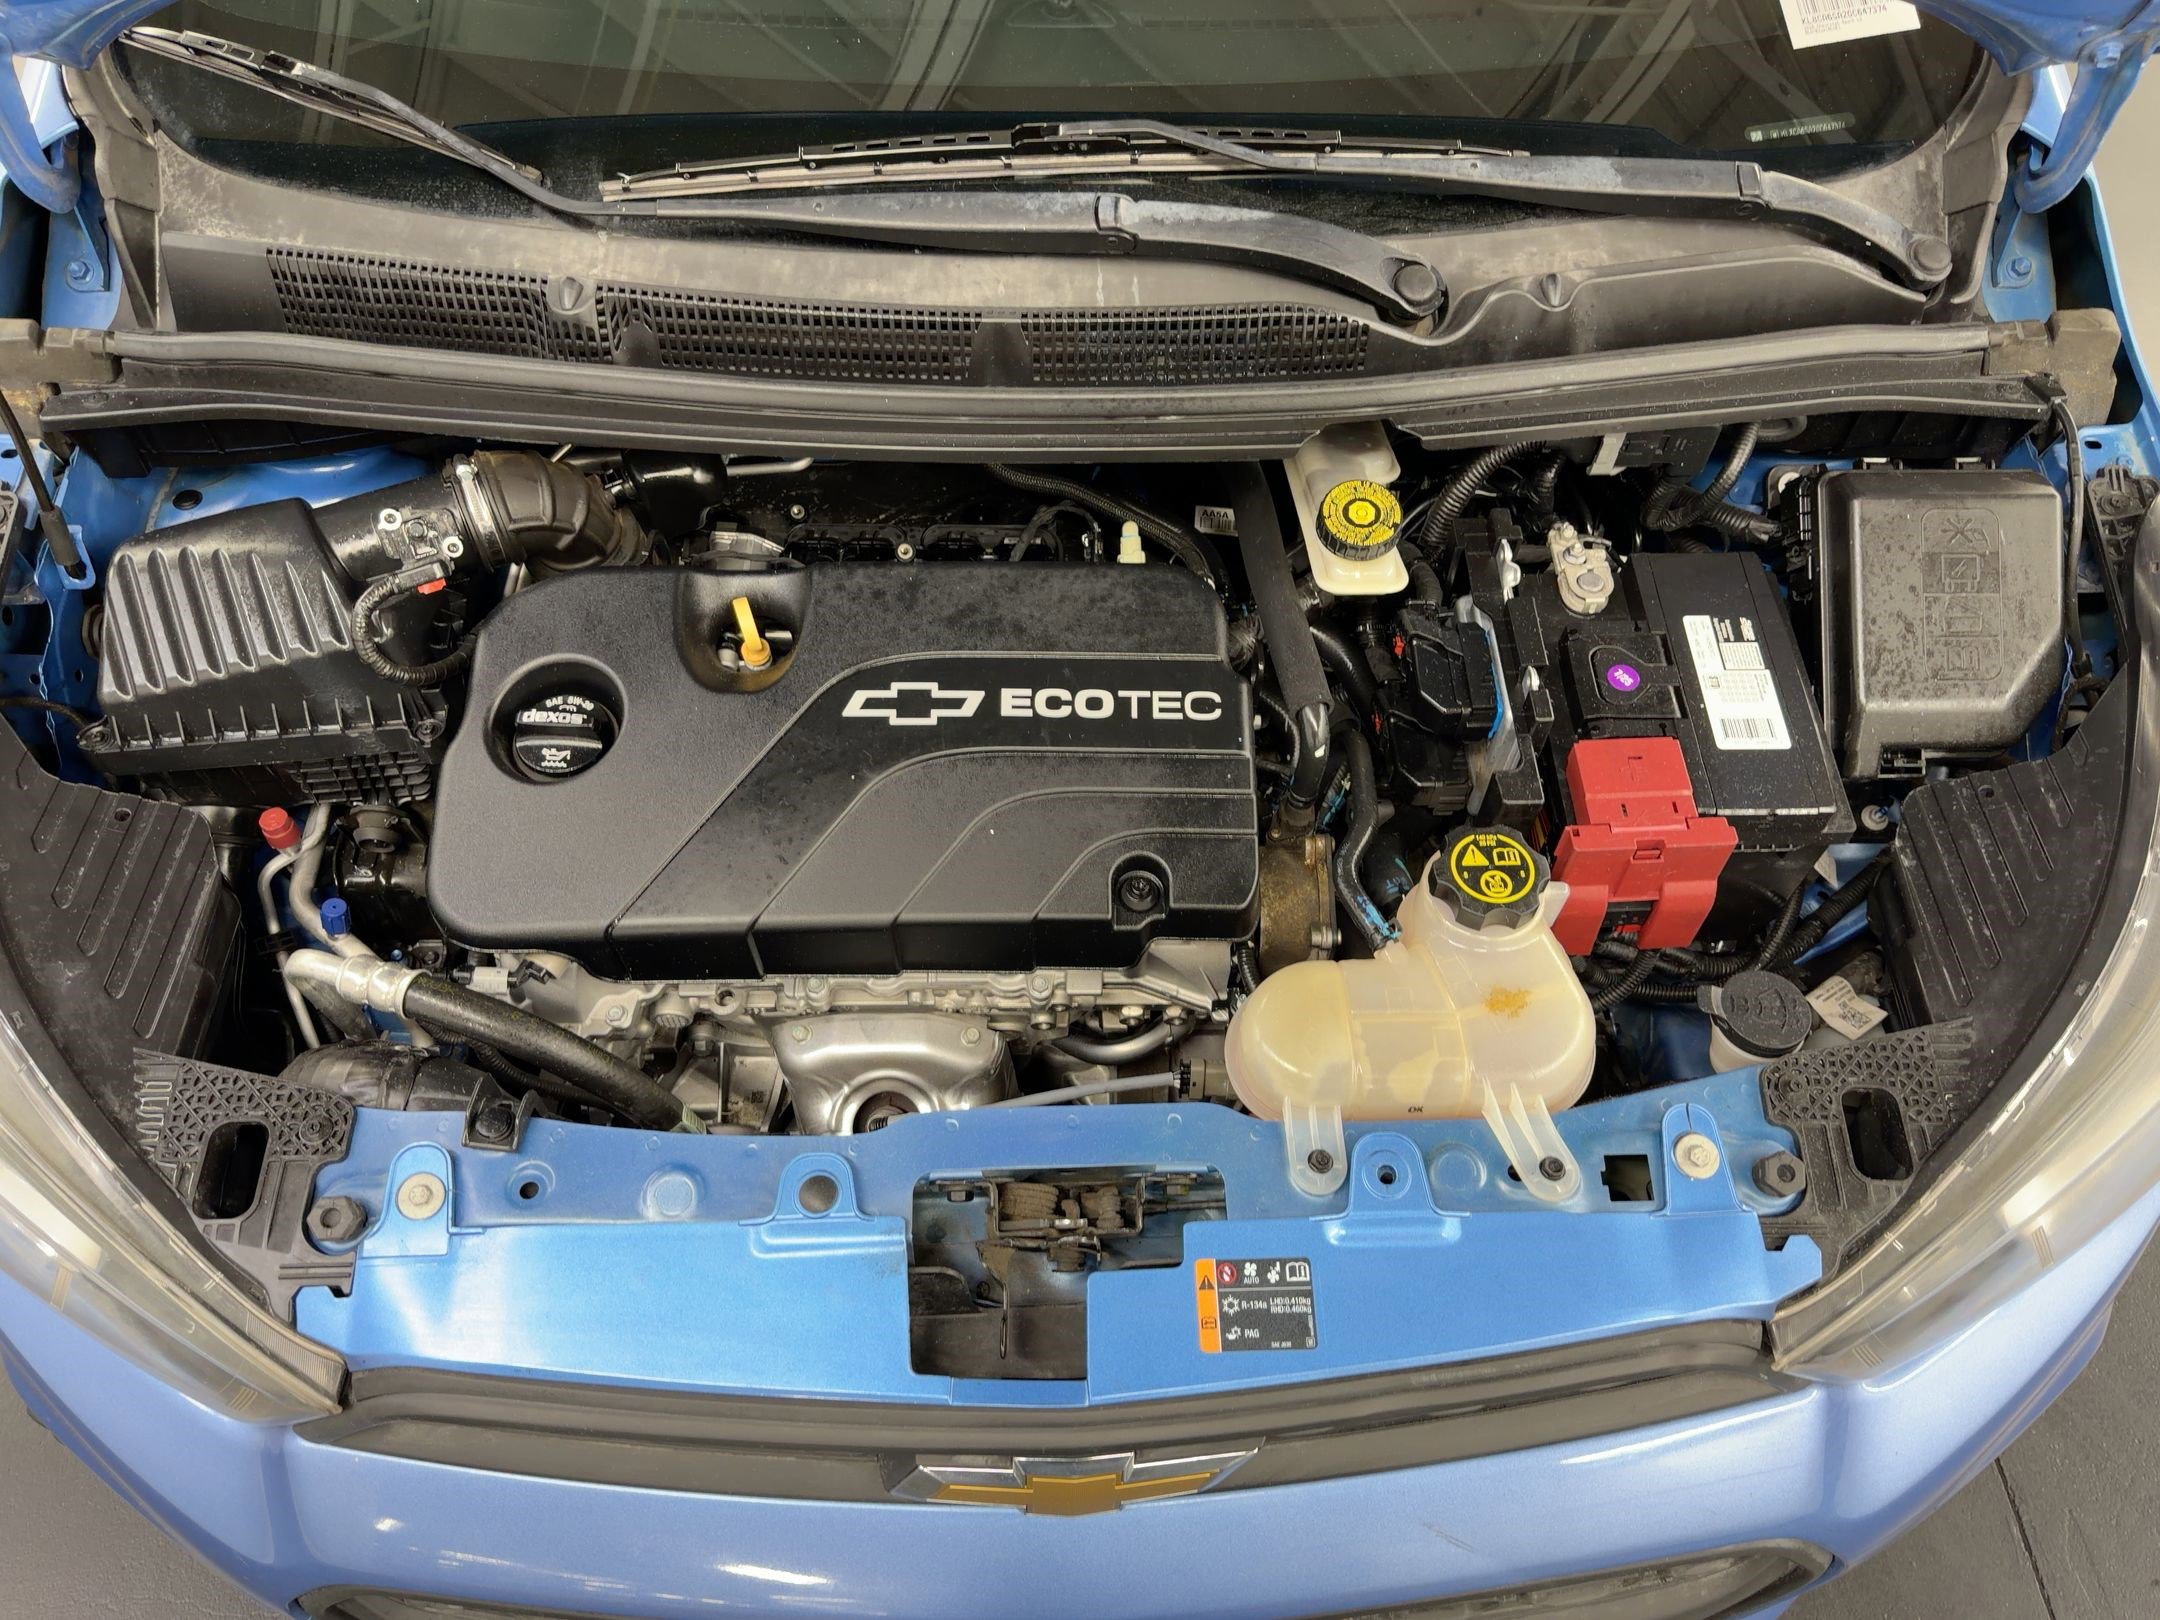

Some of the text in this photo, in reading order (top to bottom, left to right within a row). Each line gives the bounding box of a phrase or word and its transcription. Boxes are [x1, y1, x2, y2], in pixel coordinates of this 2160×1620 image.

[545, 695, 563, 708] SAE
[1000, 687, 1223, 722] ECOTEC
[522, 708, 585, 725] dexos
[1407, 1105, 1424, 1113] OK
[1243, 1276, 1260, 1285] AUTO
[1241, 1298, 1268, 1311] R-134a
[1244, 1328, 1260, 1339] PAG
